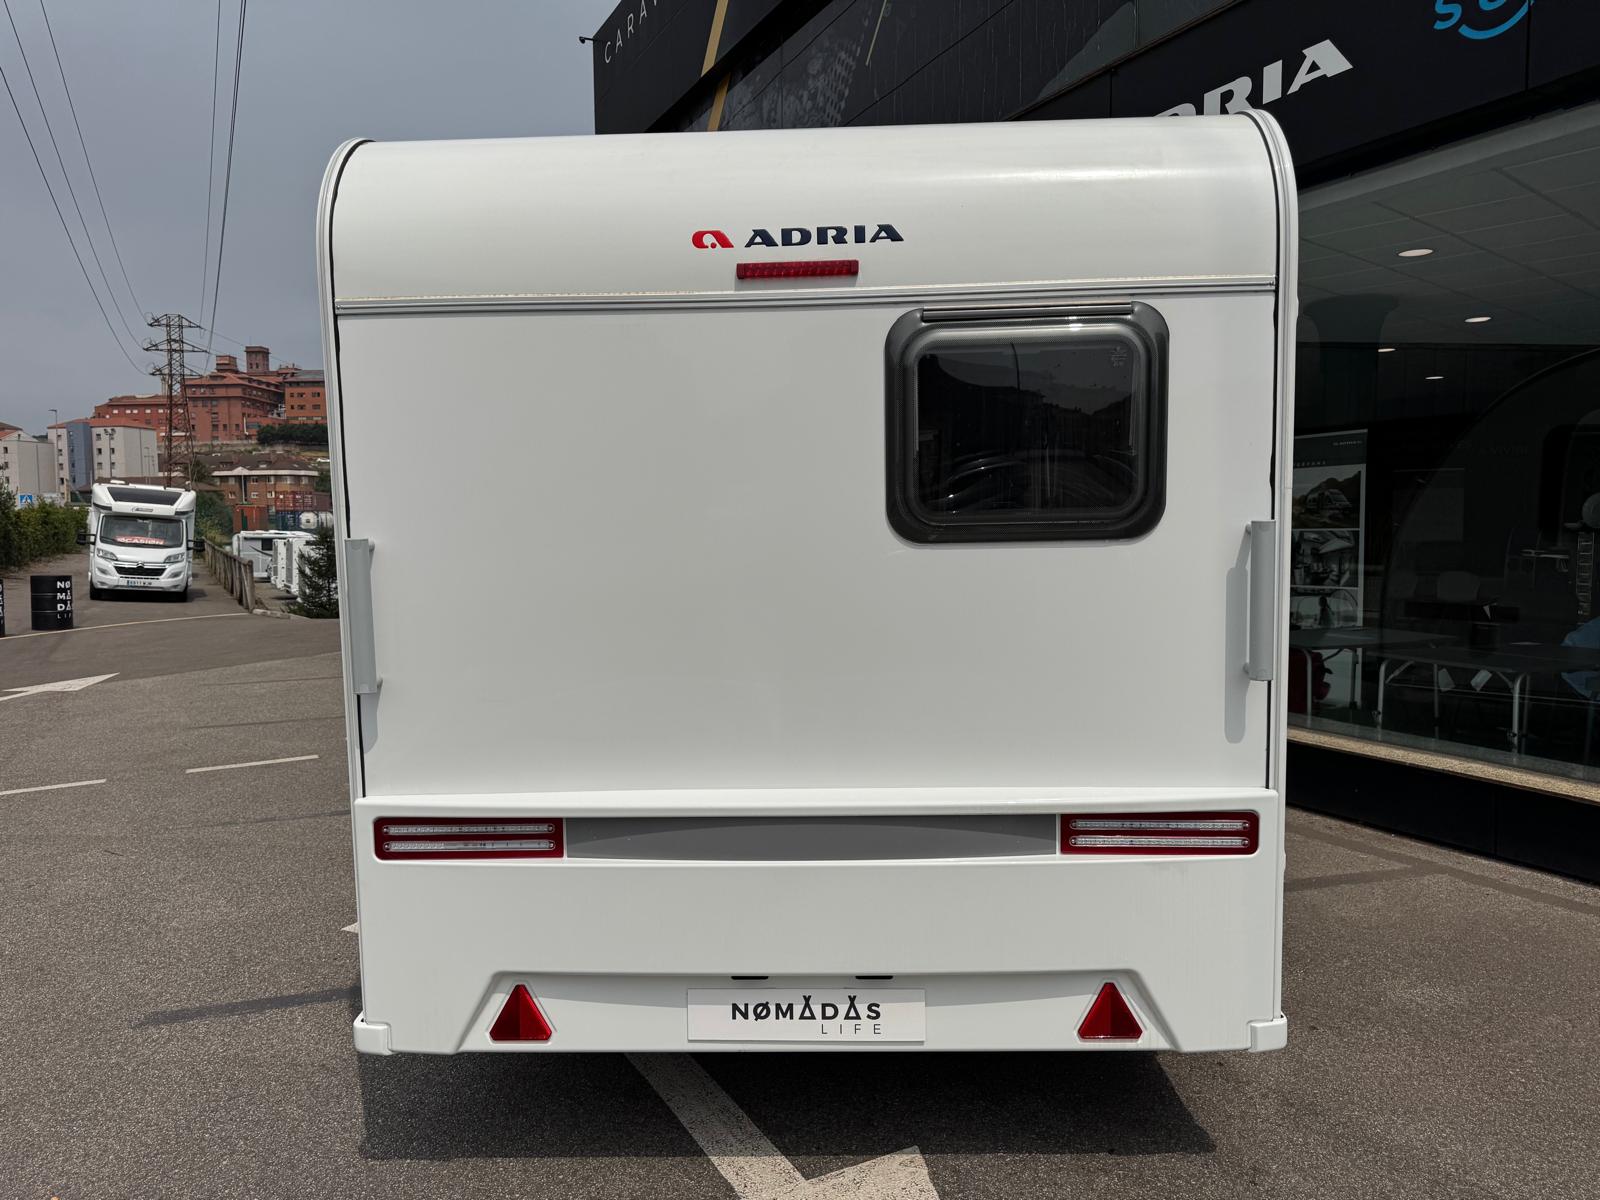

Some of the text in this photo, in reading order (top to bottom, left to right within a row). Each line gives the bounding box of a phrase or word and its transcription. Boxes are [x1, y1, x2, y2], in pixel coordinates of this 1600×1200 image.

[604, 0, 657, 64] CARA
[1153, 38, 1354, 117] RIA
[744, 223, 905, 248] ADRIA
[821, 1023, 881, 1035] LIFE
